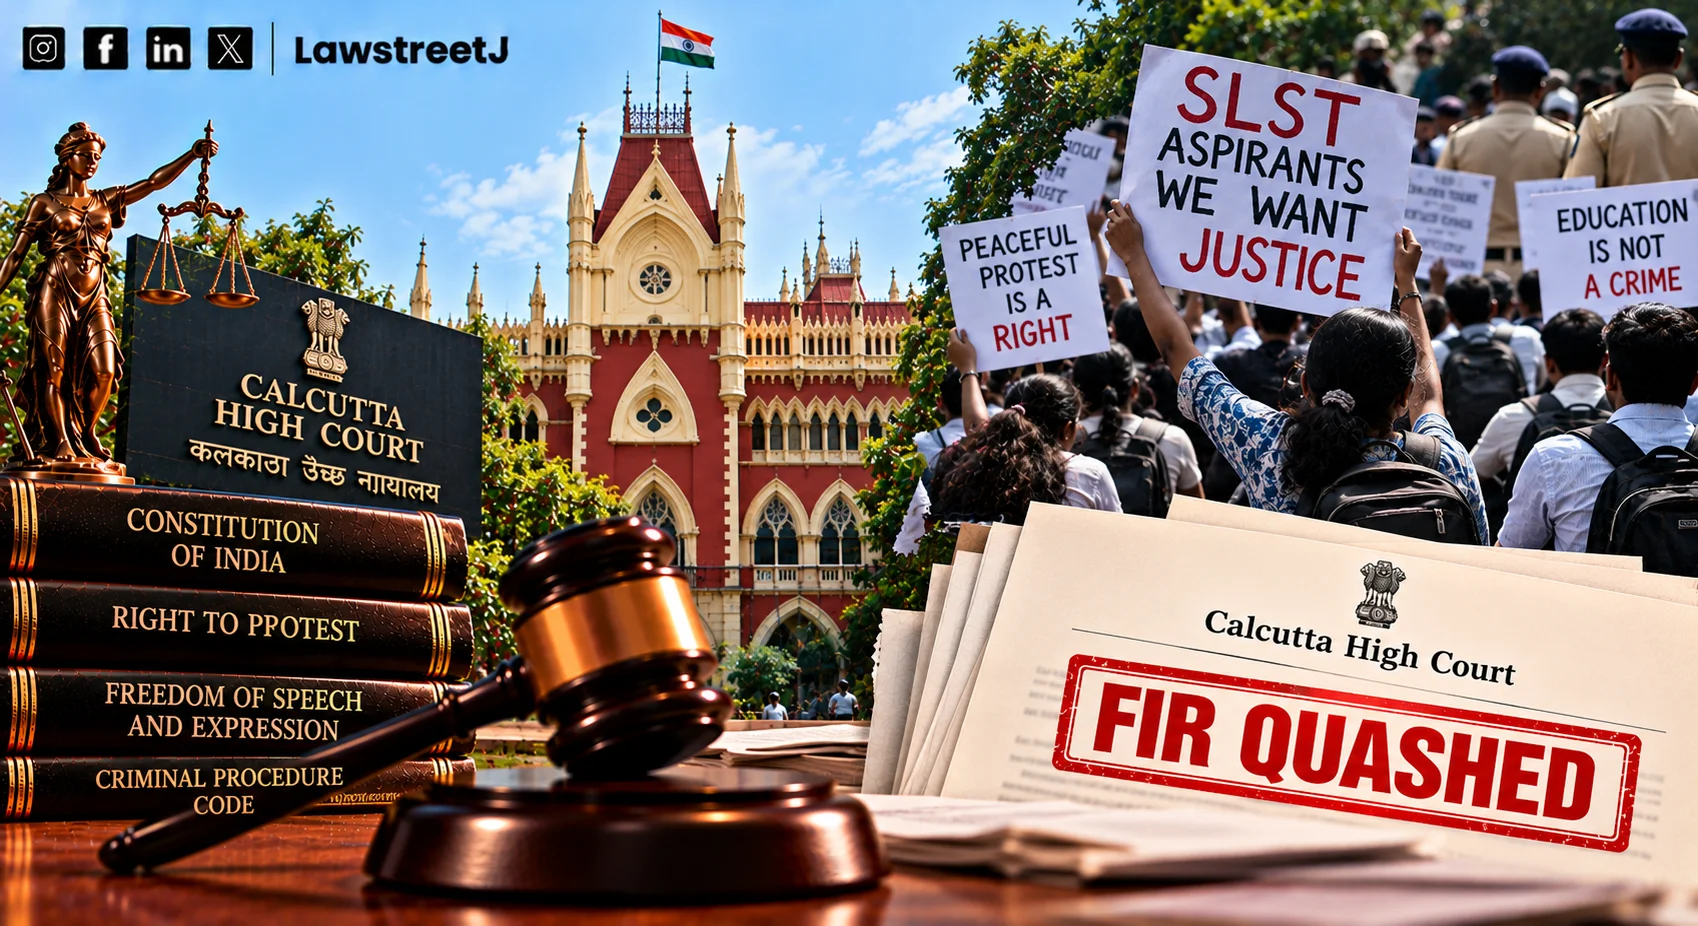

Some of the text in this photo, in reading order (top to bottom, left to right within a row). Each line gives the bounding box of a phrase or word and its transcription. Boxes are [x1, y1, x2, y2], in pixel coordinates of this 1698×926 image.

[1176, 66, 1361, 146] SLST
[1157, 127, 1365, 194] ASPIRANTS
[1156, 170, 1218, 216] WE
[1252, 186, 1368, 242] WANT
[1557, 198, 1688, 233] EDUCATION
[959, 224, 1077, 262] PEACEFUL
[1589, 234, 1664, 264] IS NOT
[979, 252, 1078, 289] PROTEST
[1180, 228, 1365, 301] JUSTICE
[1584, 266, 1682, 300] A CRIME
[1006, 288, 1052, 314] IS A
[993, 313, 1072, 352] RIGHT
[240, 373, 406, 431] CALCUTTA
[214, 398, 424, 463] HIGH COURT
[127, 507, 320, 545] CONSTITUTION
[171, 544, 286, 574] OF INDIA
[112, 606, 194, 634] RIGHT
[203, 612, 238, 636] TO
[1205, 609, 1516, 686] Calcutta High Court
[105, 682, 363, 712] FREEDOM OF SPEECH
[128, 715, 339, 742] AND EXPRESSION
[1092, 681, 1215, 768] FIR
[1240, 703, 1596, 822] QUASHED
[96, 767, 344, 790] CRIMINAL PROCEDURE
[194, 795, 254, 815] CODE
